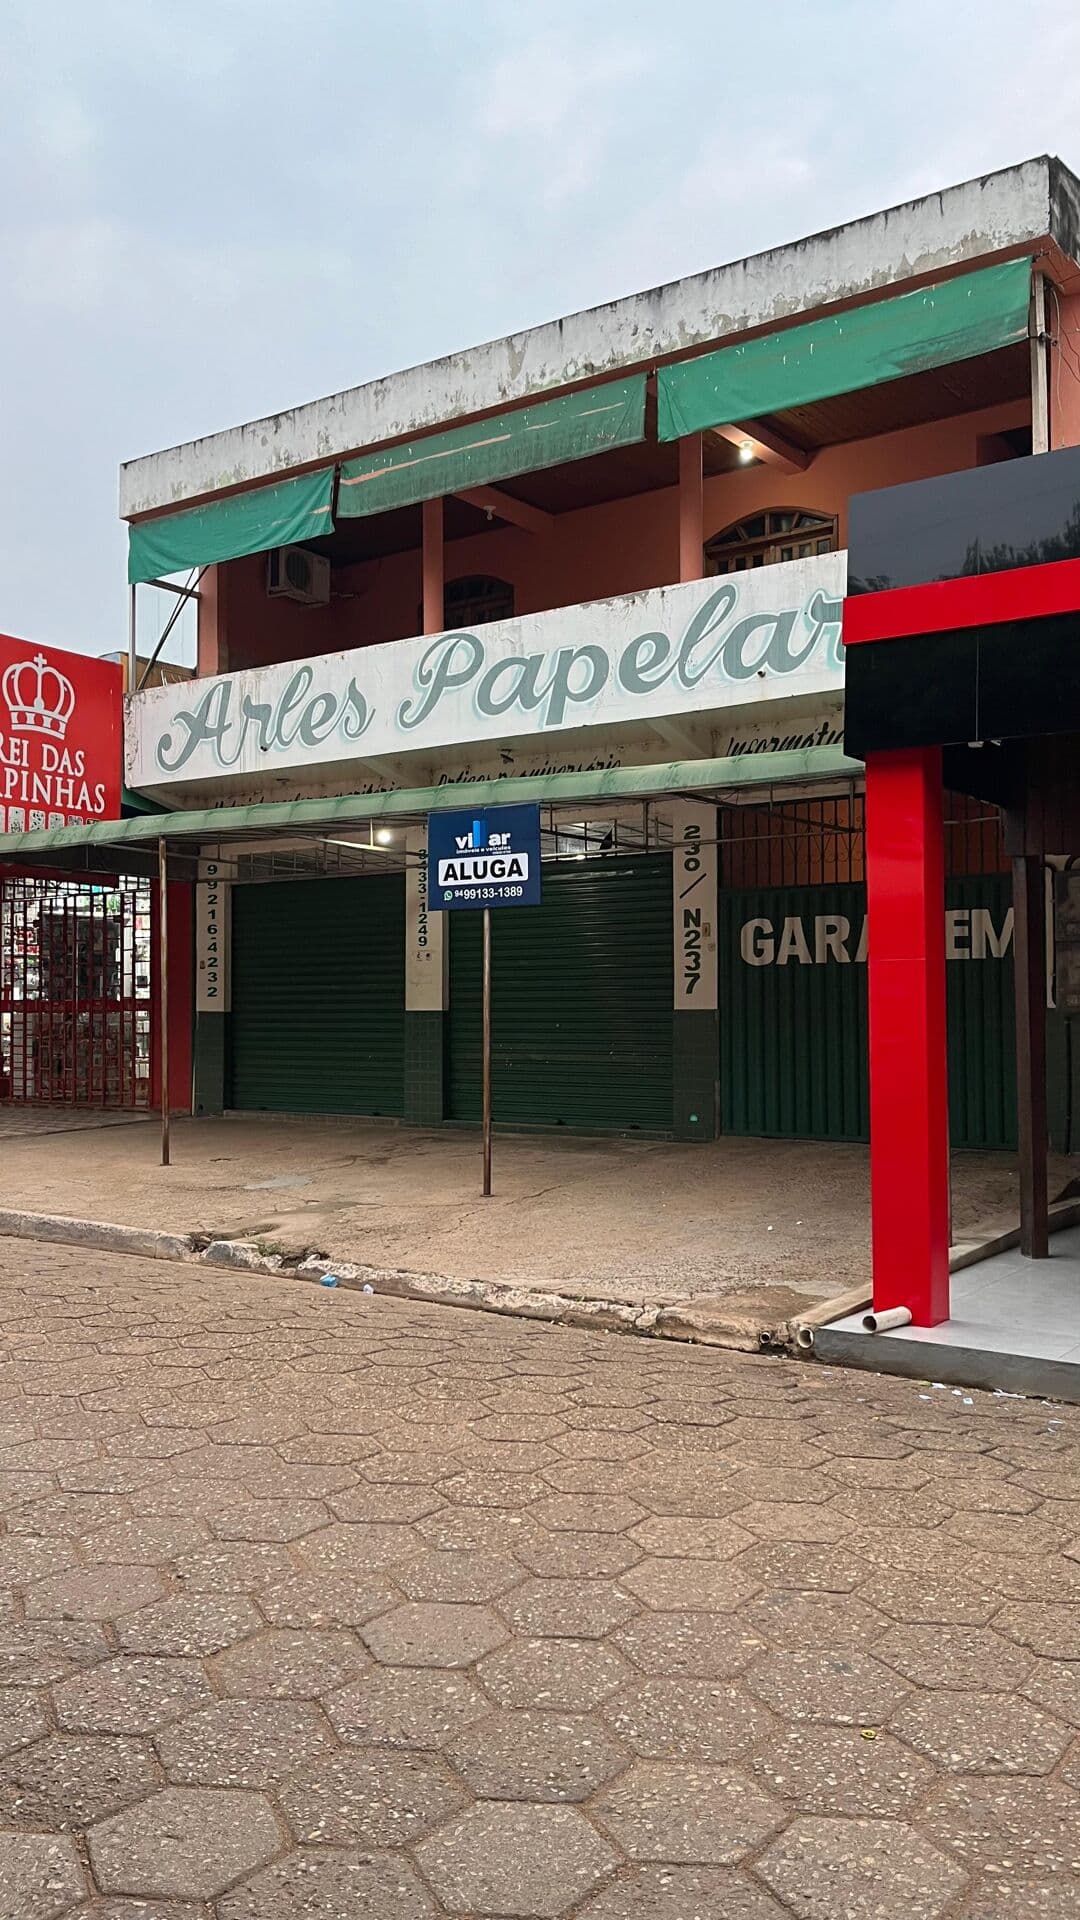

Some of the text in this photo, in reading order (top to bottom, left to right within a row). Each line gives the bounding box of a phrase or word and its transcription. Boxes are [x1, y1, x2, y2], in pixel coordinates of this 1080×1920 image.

[157, 665, 376, 772] Arles
[42, 744, 85, 777] DAS
[0, 767, 105, 813] PINHAS
[443, 858, 523, 881] ALUGA
[740, 907, 1015, 967] GAREM
